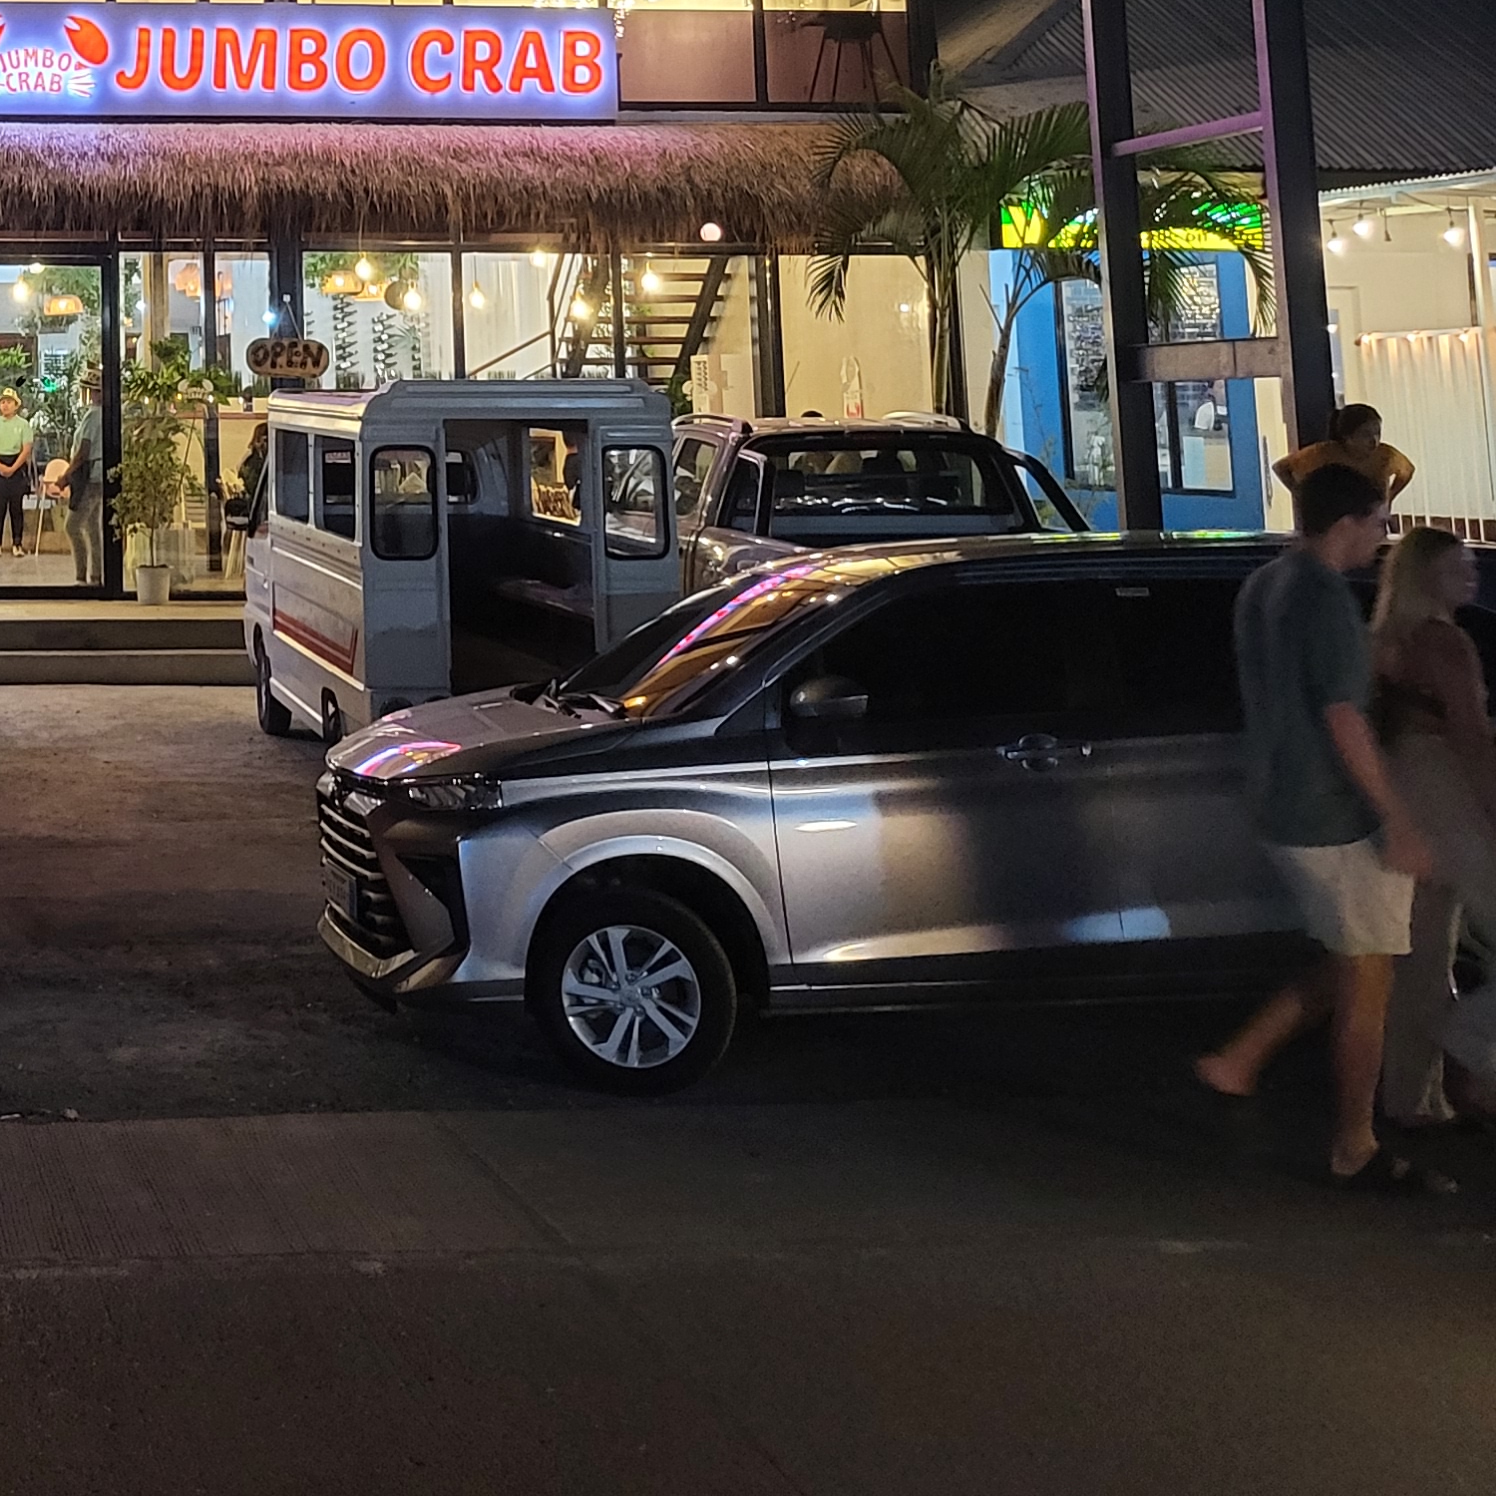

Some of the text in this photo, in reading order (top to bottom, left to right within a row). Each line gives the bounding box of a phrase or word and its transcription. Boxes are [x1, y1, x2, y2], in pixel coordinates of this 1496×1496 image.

[116, 28, 603, 95] JUMBO CRAB
[5, 71, 63, 93] CRAB
[251, 341, 324, 369] OPEN
